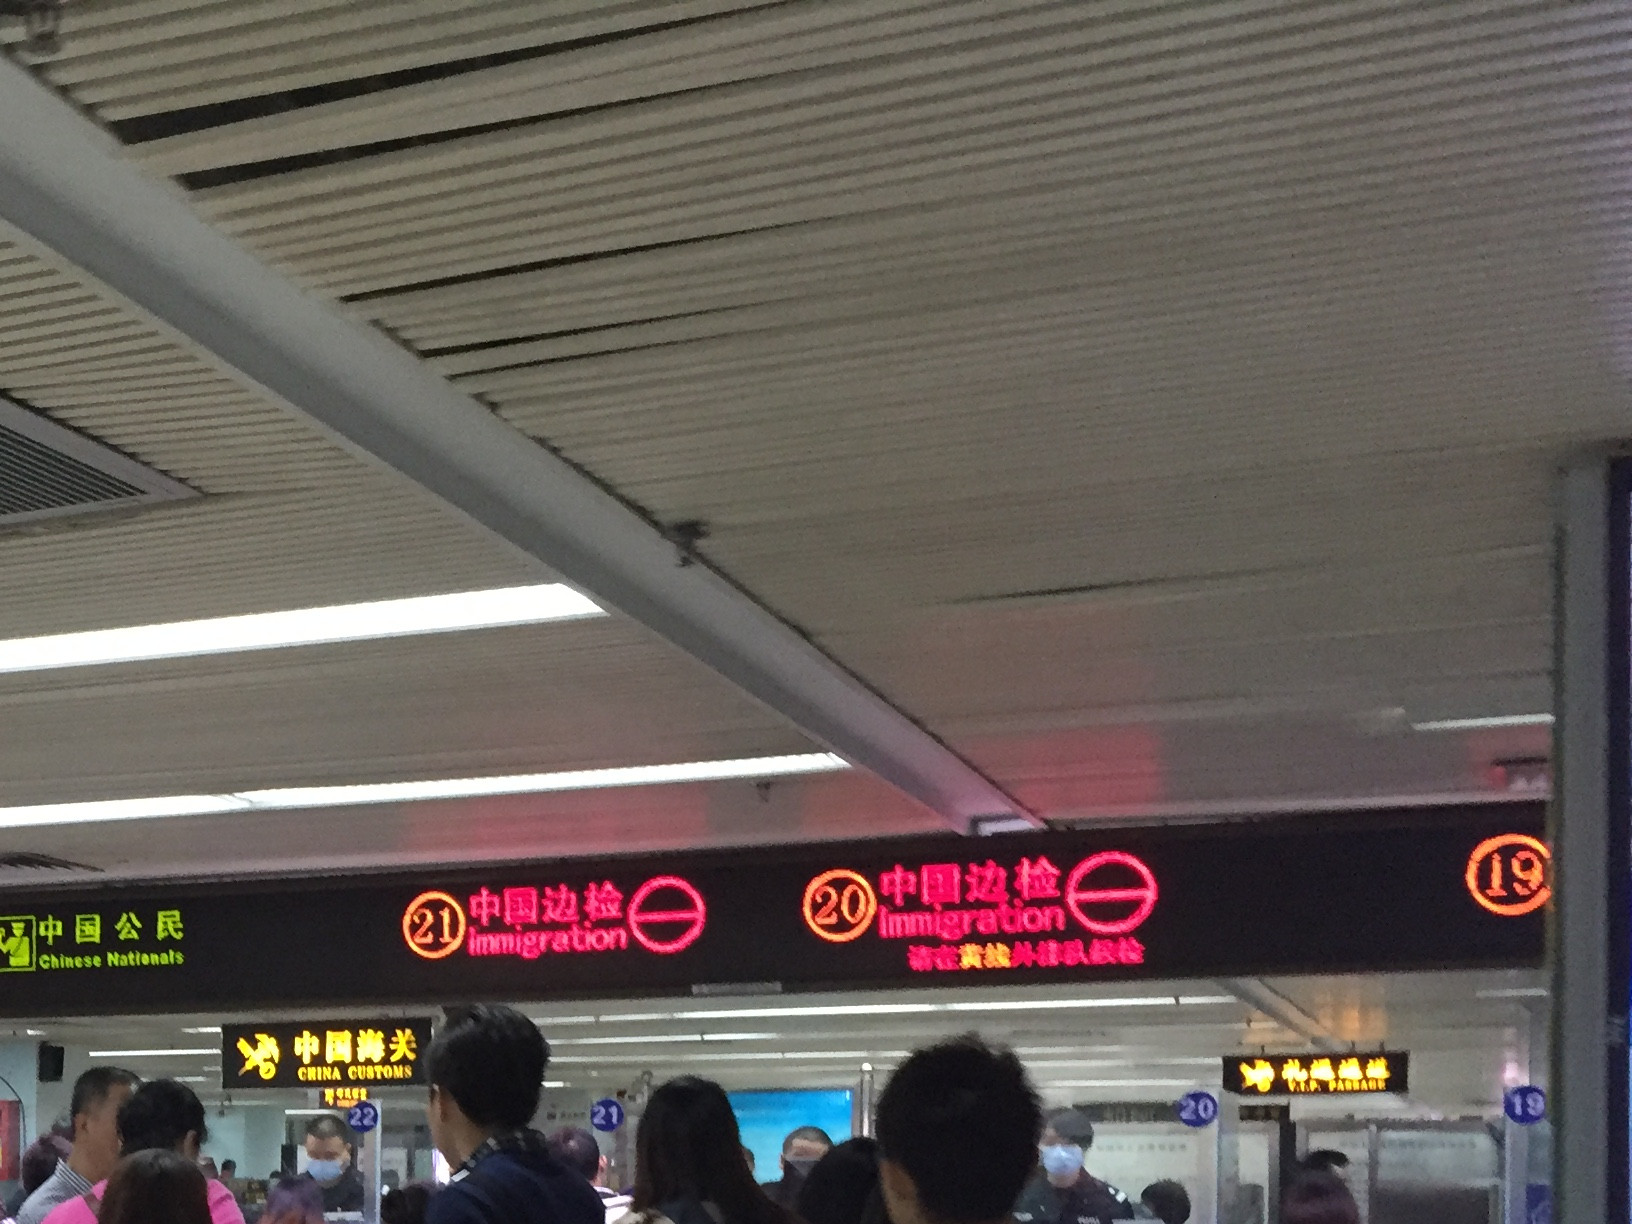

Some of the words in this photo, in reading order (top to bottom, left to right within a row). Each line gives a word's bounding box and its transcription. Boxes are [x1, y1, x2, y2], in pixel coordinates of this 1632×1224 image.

[879, 856, 1061, 906] 中国边检
[1485, 850, 1543, 896] 19
[469, 880, 624, 926] 中国边检
[814, 884, 867, 925] 20
[878, 901, 1066, 940] Immigration
[38, 909, 184, 945] 中国公民
[412, 906, 453, 945] 21
[468, 921, 628, 960] Immigration
[38, 953, 102, 970] Chinese
[106, 949, 185, 968] Nationals
[294, 1028, 418, 1065] 中国海关
[297, 1066, 342, 1081] CHINA
[347, 1064, 413, 1080] CUSTOMS
[350, 1107, 375, 1126] 22
[592, 1104, 619, 1124] 21
[1180, 1098, 1215, 1120] 20
[1507, 1091, 1545, 1116] 19
